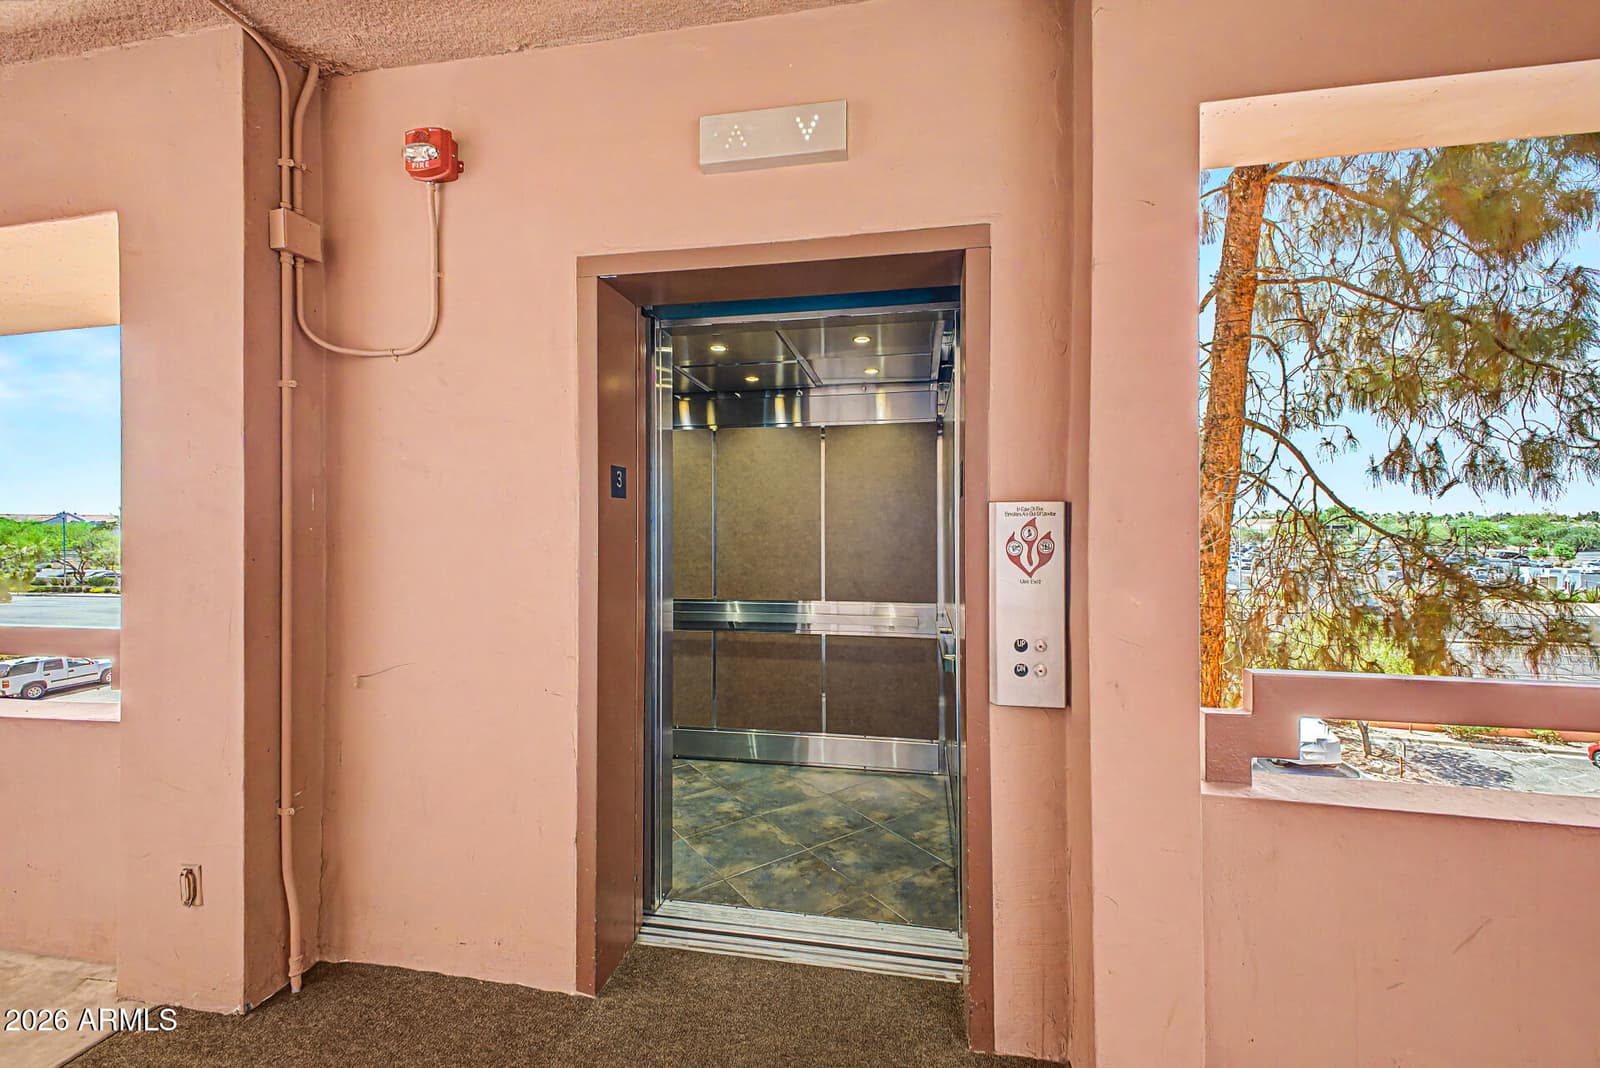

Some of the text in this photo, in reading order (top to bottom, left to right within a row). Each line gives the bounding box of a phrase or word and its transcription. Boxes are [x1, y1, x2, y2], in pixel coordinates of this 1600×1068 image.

[411, 161, 430, 169] FIRE
[616, 470, 623, 488] 3
[1017, 639, 1026, 648] UP
